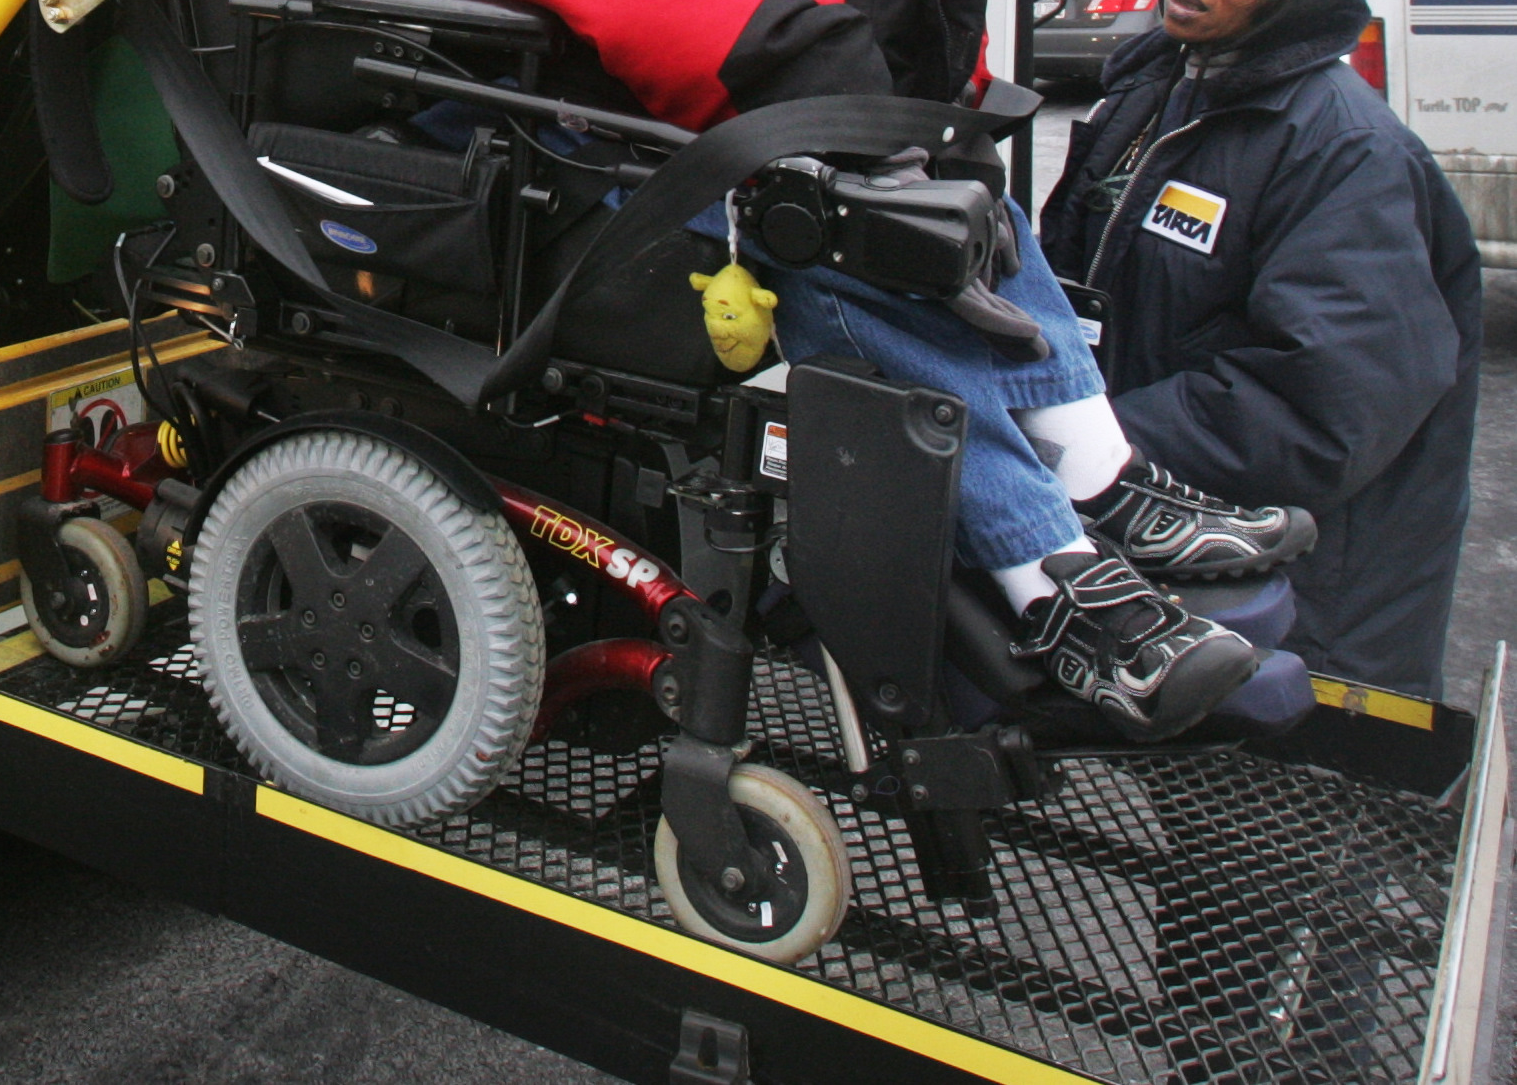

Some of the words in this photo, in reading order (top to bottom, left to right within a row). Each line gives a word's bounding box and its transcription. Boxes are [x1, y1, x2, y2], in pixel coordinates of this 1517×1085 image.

[1452, 97, 1481, 112] TOP
[1151, 203, 1213, 245] TARTA
[83, 376, 121, 396] CAUTION
[530, 505, 614, 568] TDX
[606, 548, 660, 588] SP
